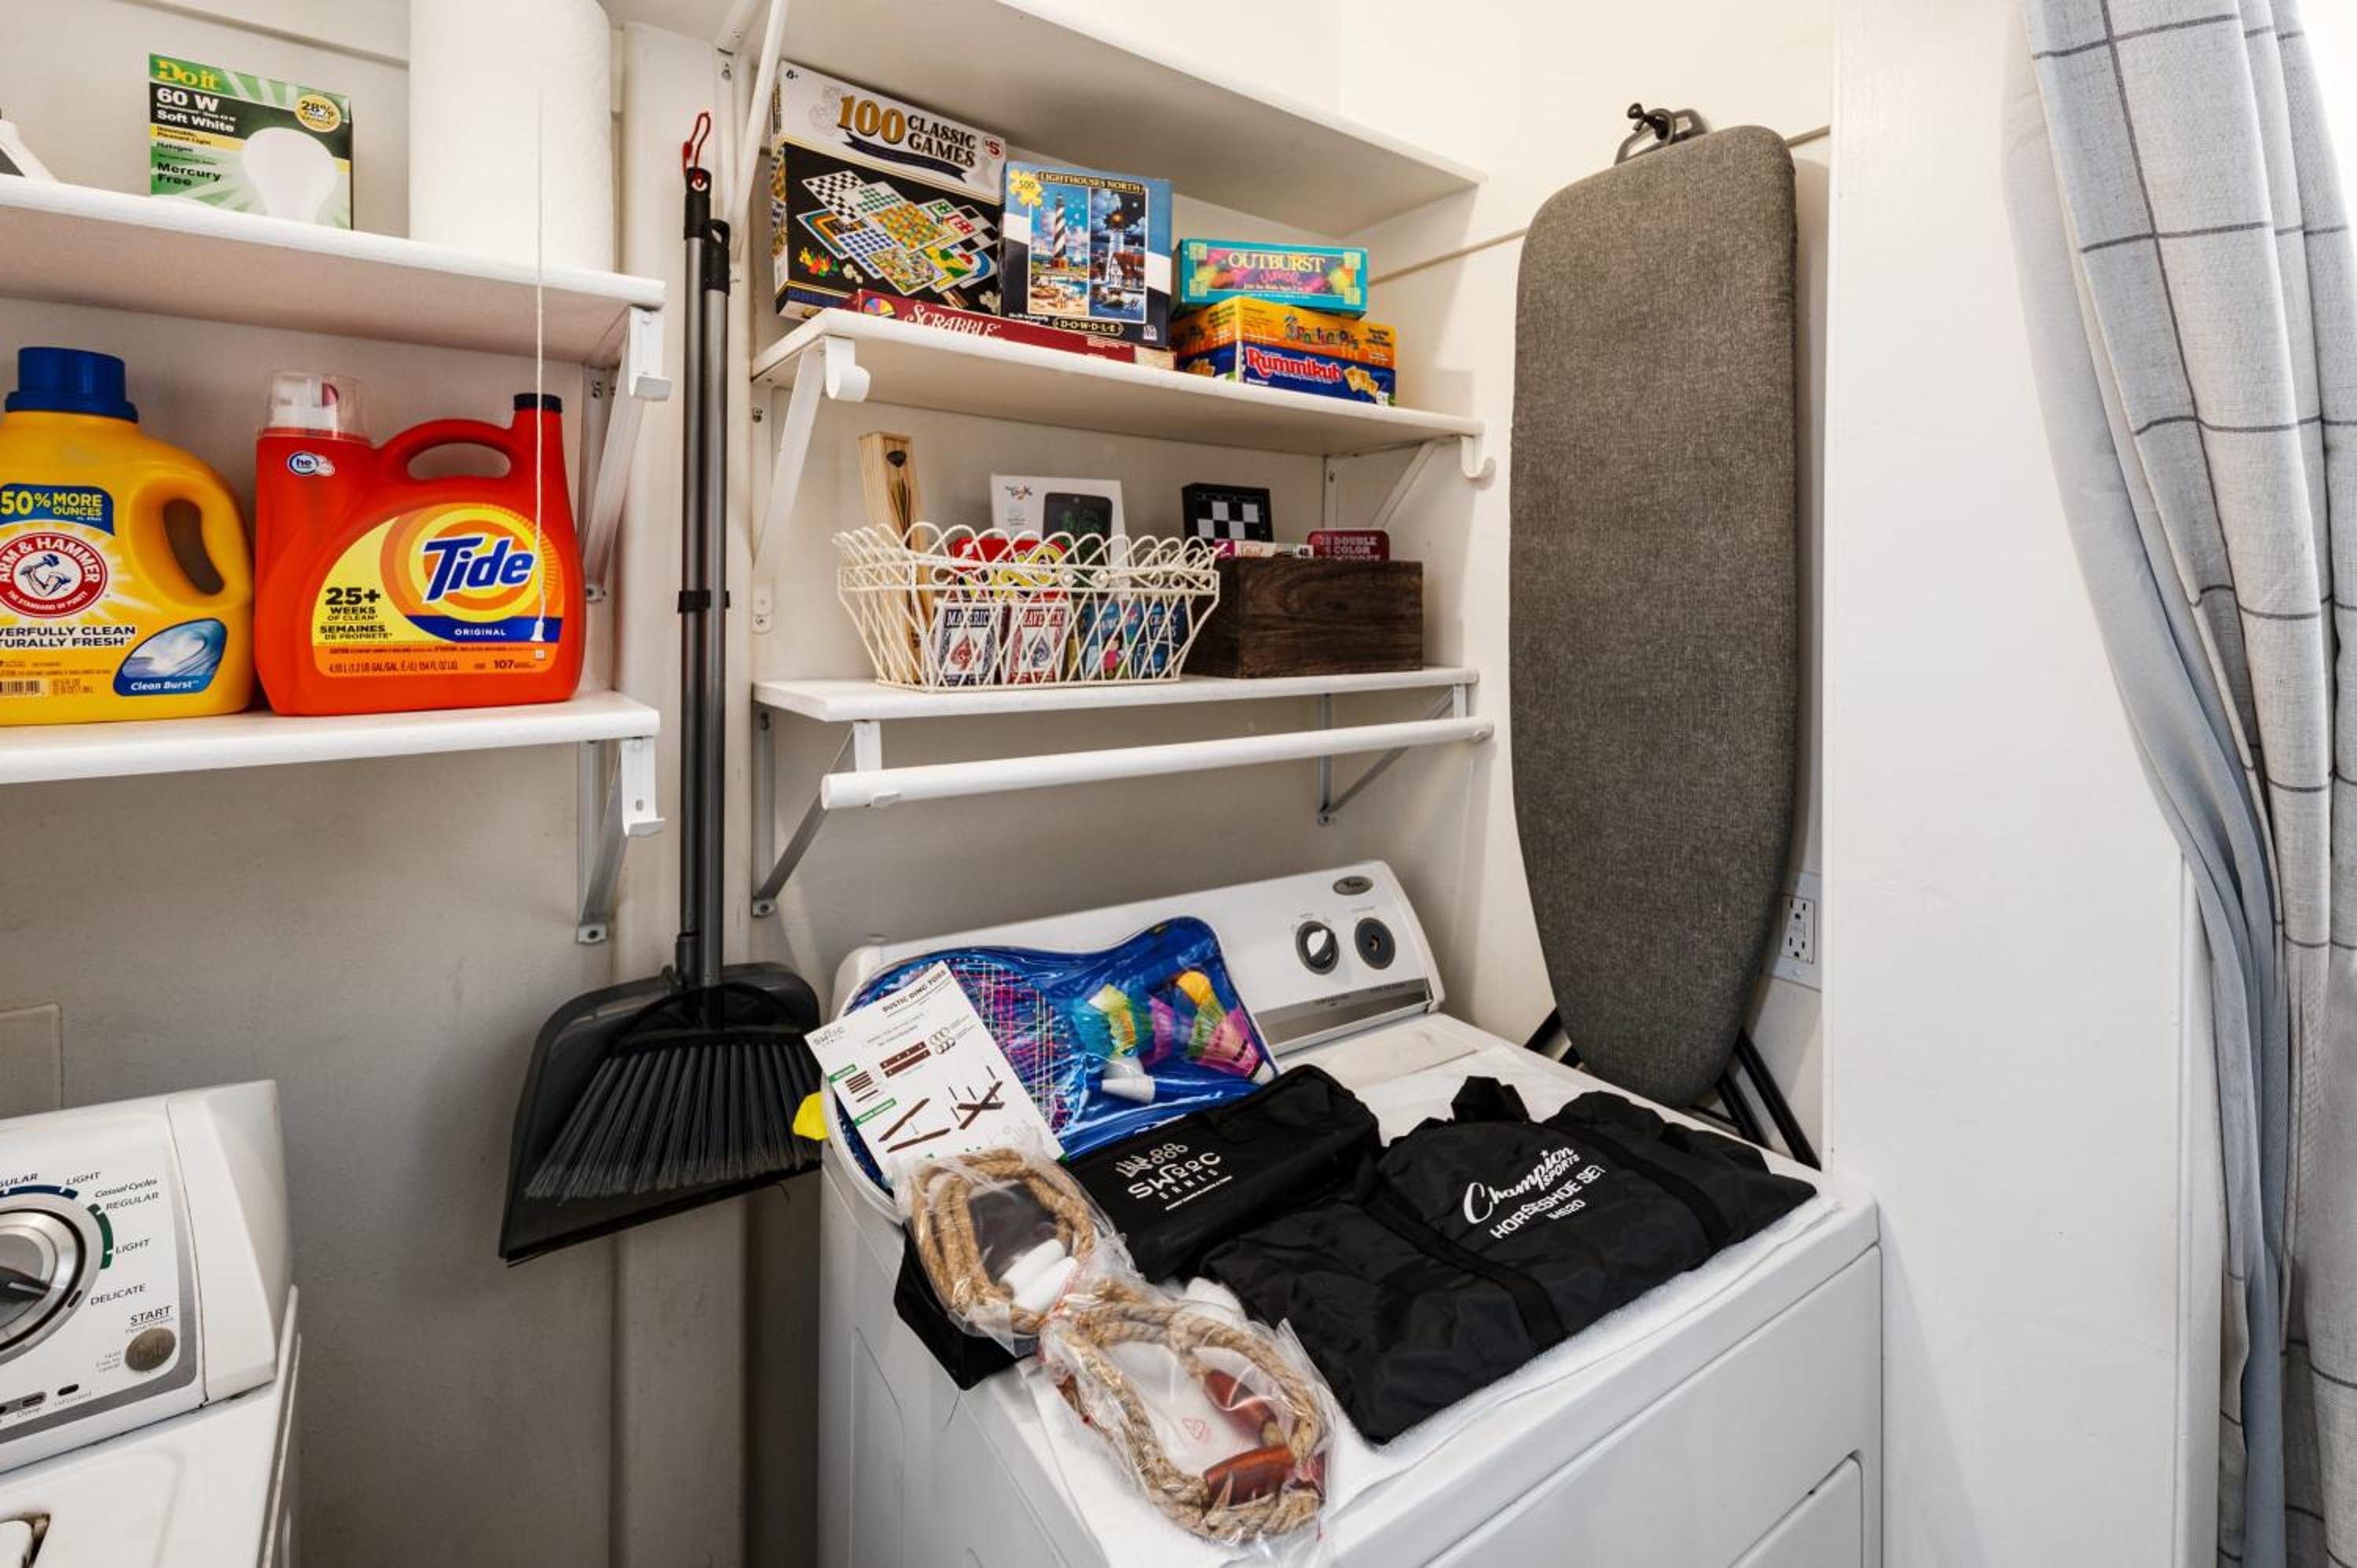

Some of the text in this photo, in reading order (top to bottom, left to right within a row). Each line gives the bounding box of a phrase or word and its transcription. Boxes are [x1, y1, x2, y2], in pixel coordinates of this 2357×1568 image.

[157, 88, 219, 112] 60 W
[157, 110, 188, 124] Soft
[191, 115, 235, 133] White
[837, 94, 977, 149] 100 CLASSIC
[907, 133, 976, 168] GAMES
[157, 163, 222, 182] Mercury
[157, 174, 192, 187] Free
[1041, 171, 1140, 192] LIGHTHOUSES NORTH
[1228, 251, 1325, 273] OUTBURST
[905, 304, 1001, 336] SCRABBLE
[1245, 346, 1342, 382] Rummikub
[296, 458, 313, 467] he
[0, 491, 103, 515] 50% MORE
[53, 507, 103, 516] OUNCES
[1334, 537, 1377, 546] DOUBLE
[18, 541, 34, 553] &
[35, 537, 102, 583] HAMMER
[423, 536, 535, 603] Tide
[325, 587, 380, 605] 25+
[81, 626, 136, 636] CLEAN
[320, 625, 386, 634] SEMAINES
[493, 660, 515, 669] 107
[130, 680, 192, 691] Clean Burst
[66, 1171, 101, 1185] LIGHT
[1542, 1154, 1581, 1185] SPORTS
[95, 1178, 158, 1198] Casual Cycles
[1464, 1147, 1574, 1225] Champion
[106, 1192, 159, 1211] REGULAR
[1489, 1164, 1607, 1239] HORSESHOE SET
[115, 1237, 152, 1255] LIGHT
[90, 1283, 147, 1306] DELICATE
[130, 1305, 173, 1323] START
